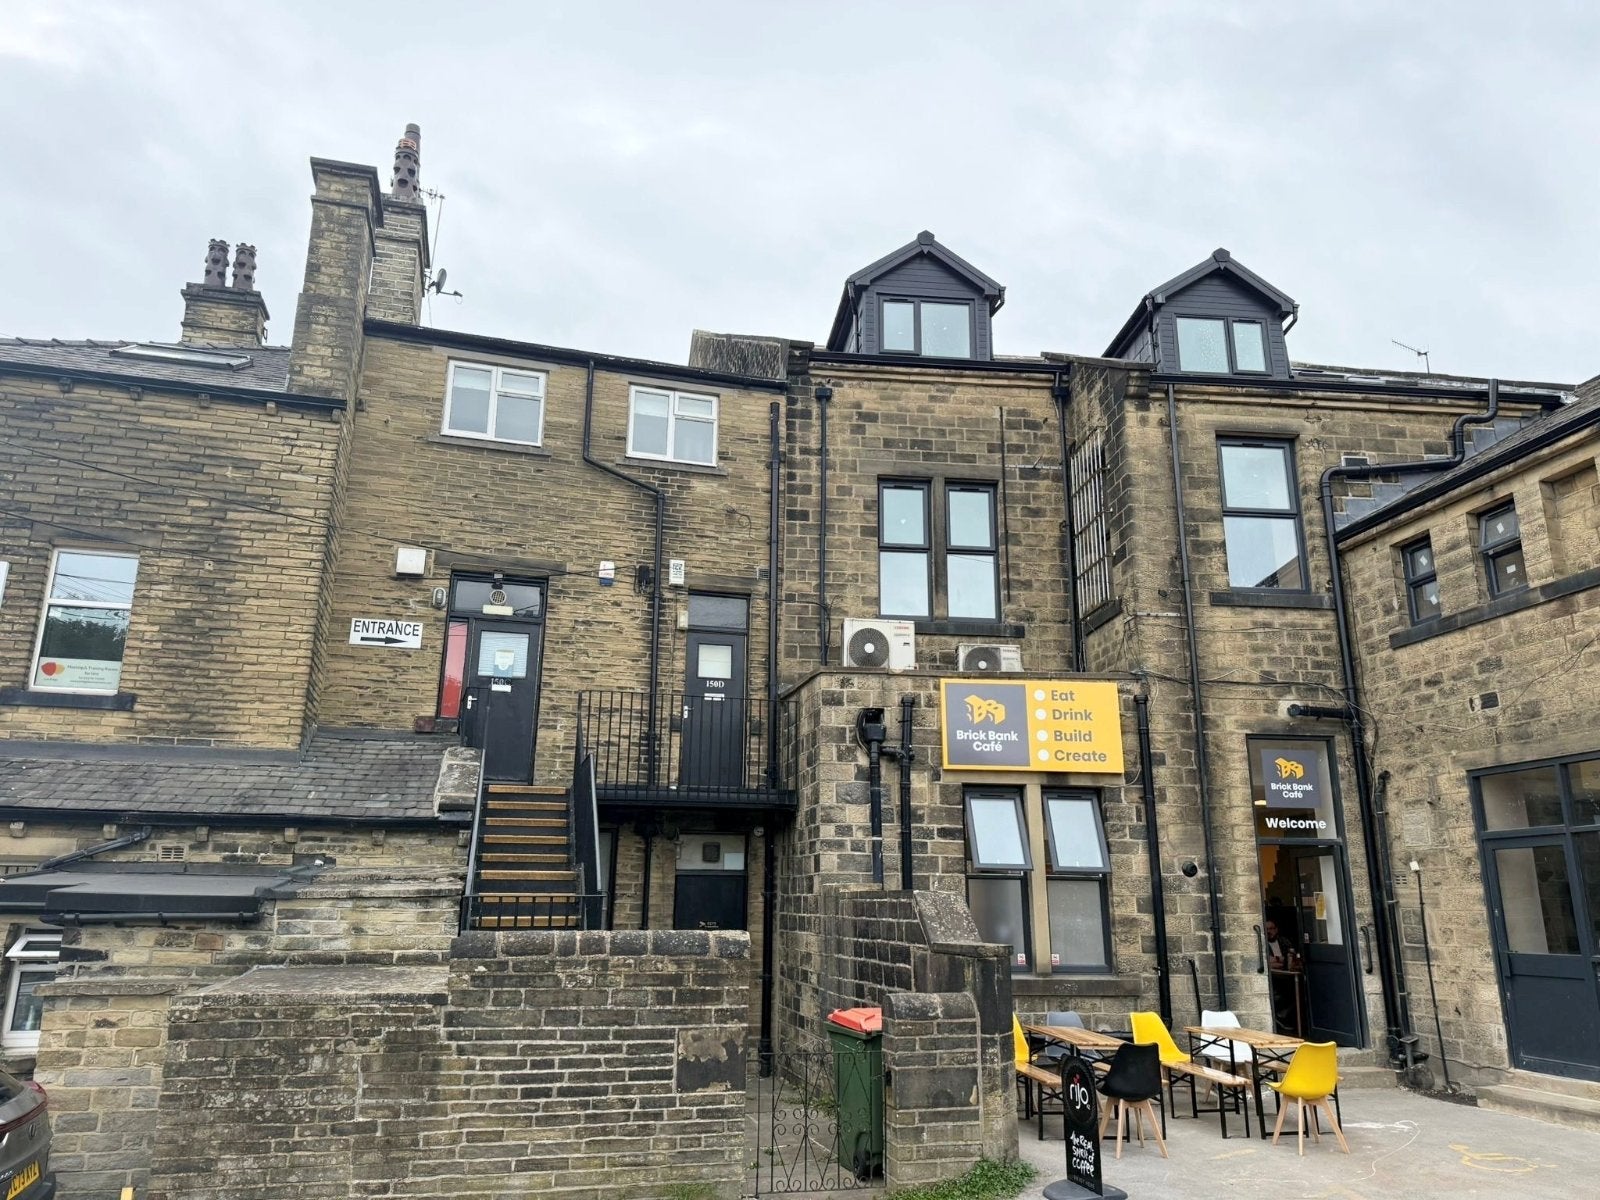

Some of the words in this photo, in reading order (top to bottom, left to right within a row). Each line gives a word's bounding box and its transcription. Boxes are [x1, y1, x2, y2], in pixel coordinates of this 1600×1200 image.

[353, 620, 420, 637] ENTRANCE
[706, 680, 725, 688] 150D
[1051, 690, 1075, 702] Eat
[1052, 708, 1093, 721] Drink
[956, 729, 987, 741] Brick
[988, 730, 1018, 741] Bank
[1054, 730, 1092, 742] Build
[973, 741, 1003, 752] Café
[1054, 750, 1107, 762] Create
[1270, 782, 1292, 790] Brick
[1292, 783, 1313, 791] Bank
[1282, 790, 1303, 799] Café
[1265, 817, 1327, 830] Welcome
[1070, 1075, 1089, 1110] rijo
